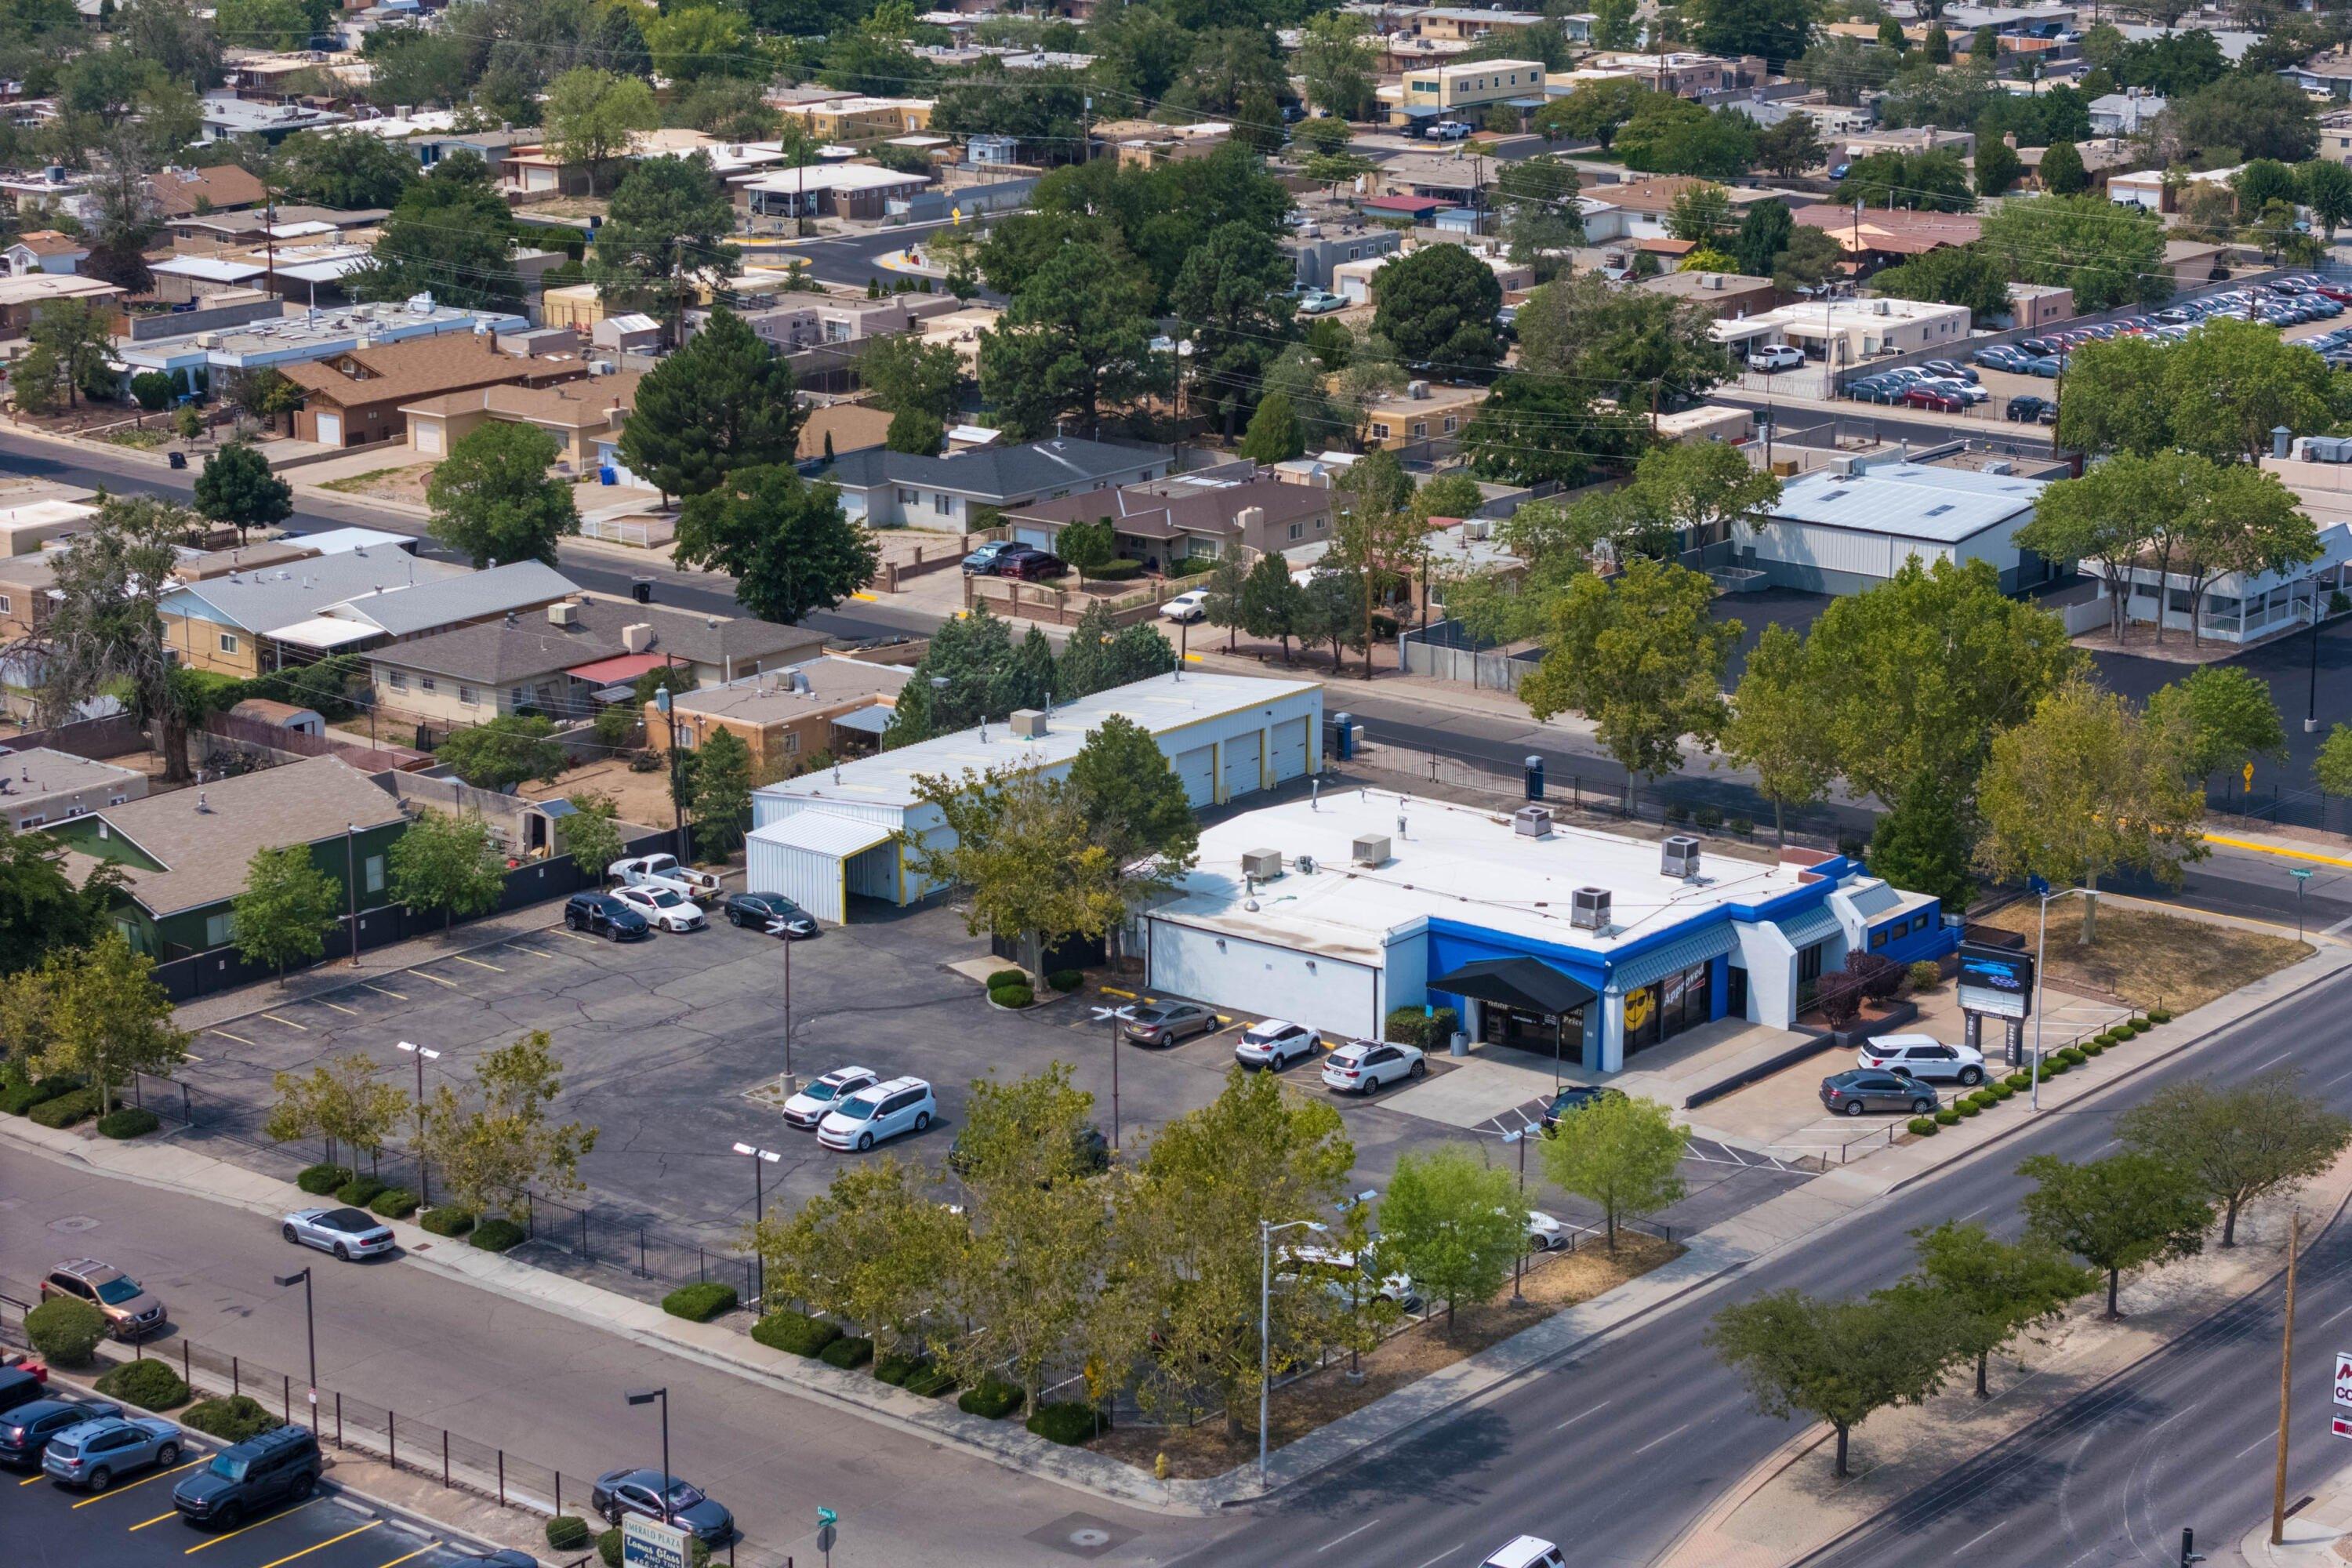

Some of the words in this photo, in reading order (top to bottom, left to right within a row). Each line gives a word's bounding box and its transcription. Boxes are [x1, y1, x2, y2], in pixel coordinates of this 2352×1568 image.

[1663, 962, 1704, 1007] Approved
[625, 1521, 655, 1539] EMERALD
[658, 1534, 681, 1549] PLAZA
[626, 1536, 653, 1555] Lomas
[656, 1548, 681, 1564] Glass
[644, 1553, 661, 1563] AND
